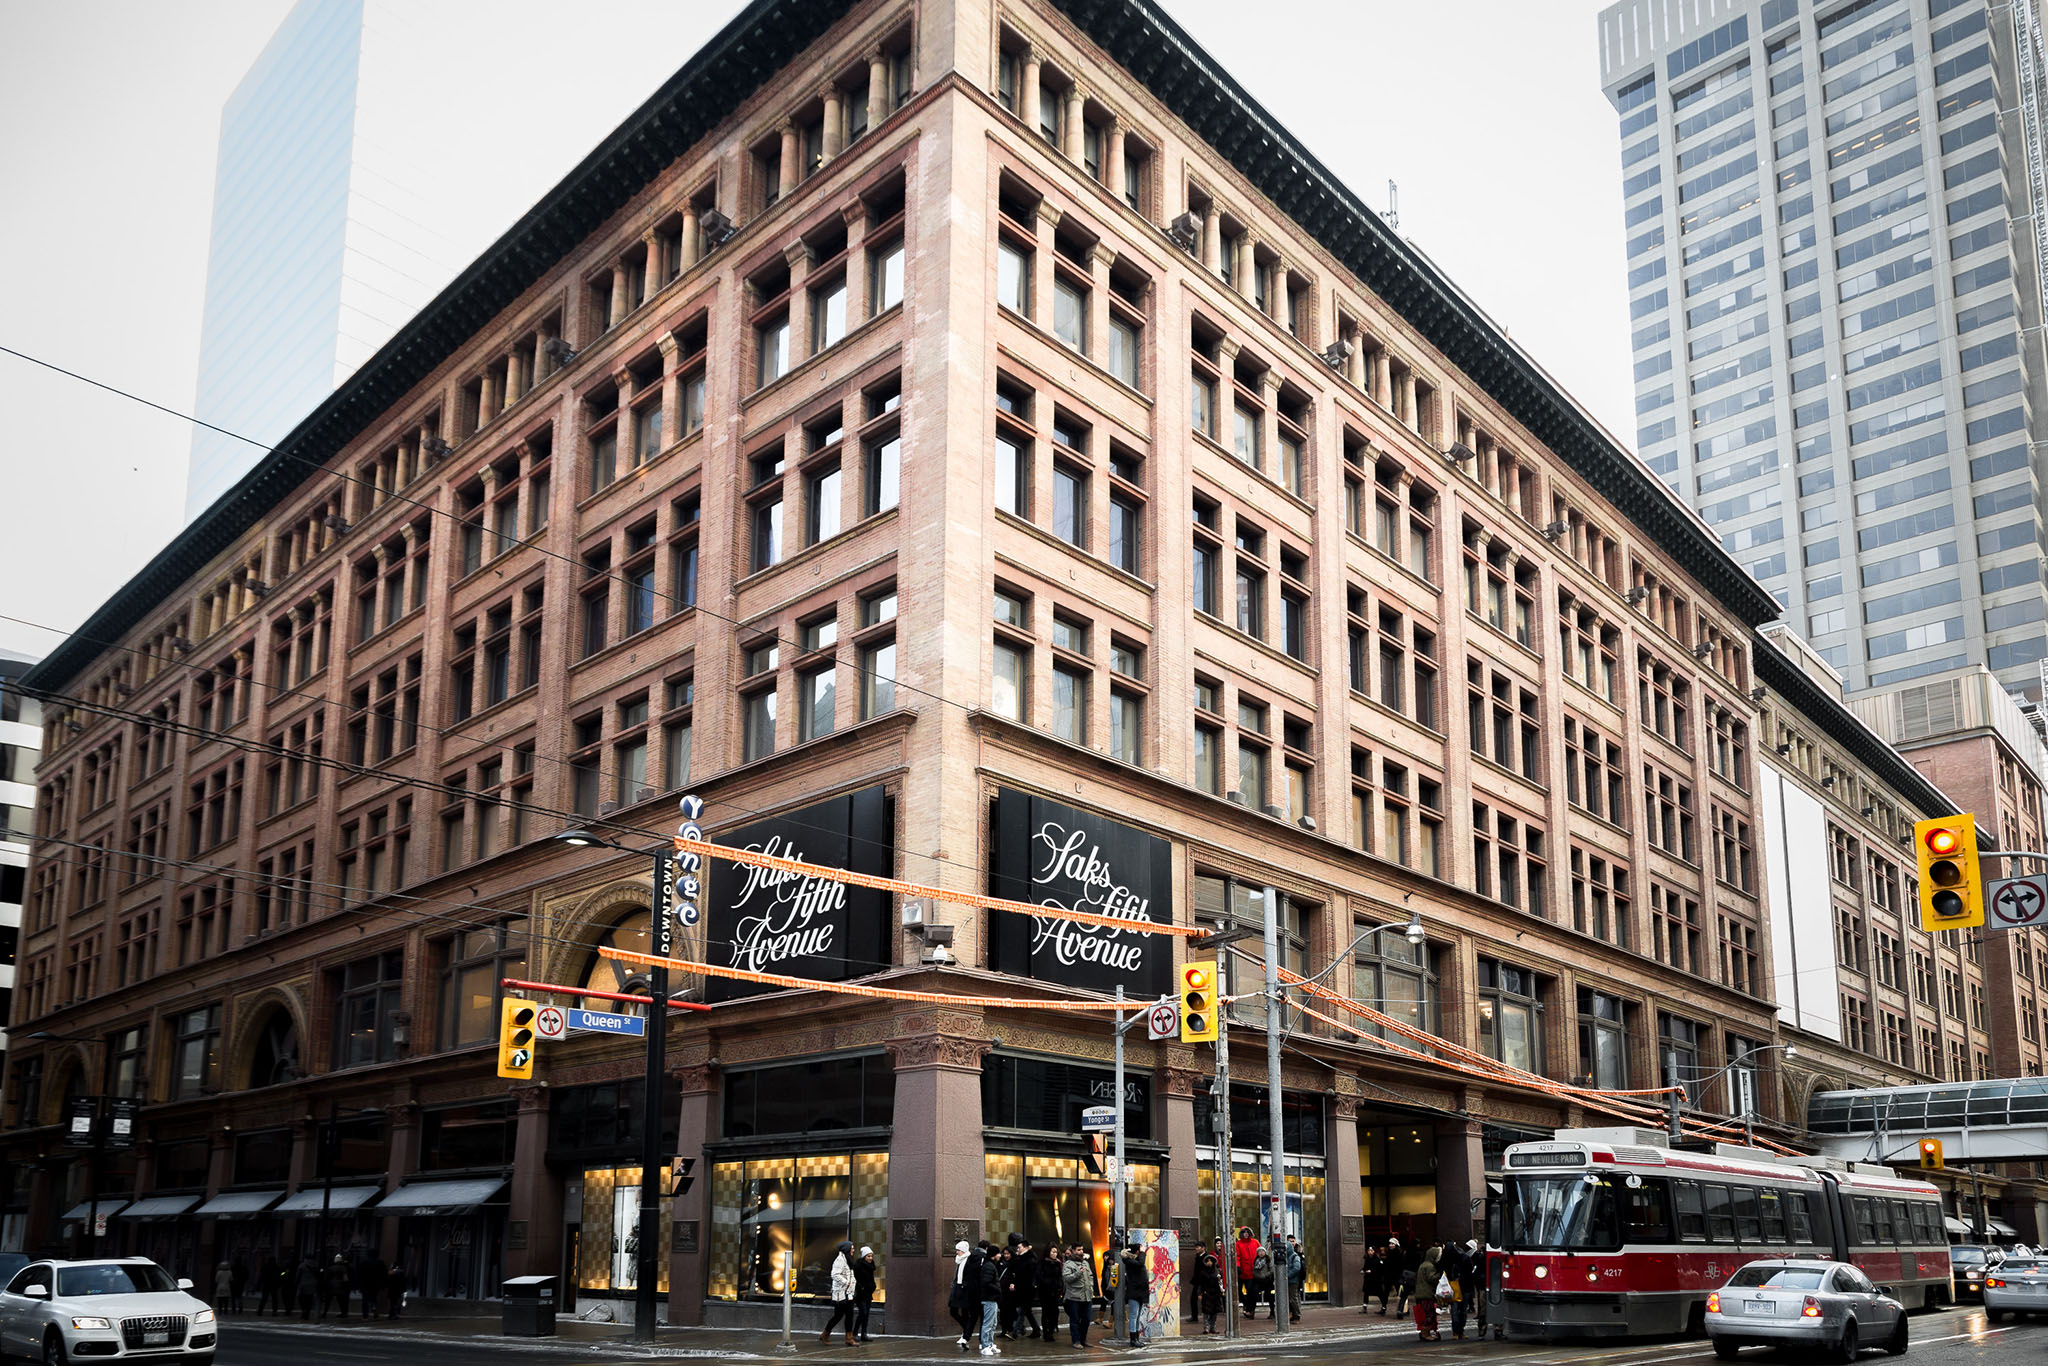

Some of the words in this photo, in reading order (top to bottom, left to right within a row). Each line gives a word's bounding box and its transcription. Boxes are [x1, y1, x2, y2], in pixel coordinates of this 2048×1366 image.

[1032, 822, 1111, 888] Saks
[661, 858, 673, 953] DOWNTOWN
[1032, 898, 1142, 971] Avenue
[729, 916, 834, 973] Avenue
[582, 1012, 621, 1029] Queen
[624, 1017, 631, 1025] St
[1088, 1116, 1104, 1125] Yonge
[1538, 1144, 1555, 1152] 4217
[1512, 1155, 1525, 1165] 501
[1531, 1154, 1559, 1164] NEVILLE
[1560, 1154, 1579, 1164] PARK
[1604, 1268, 1623, 1277] 4217
